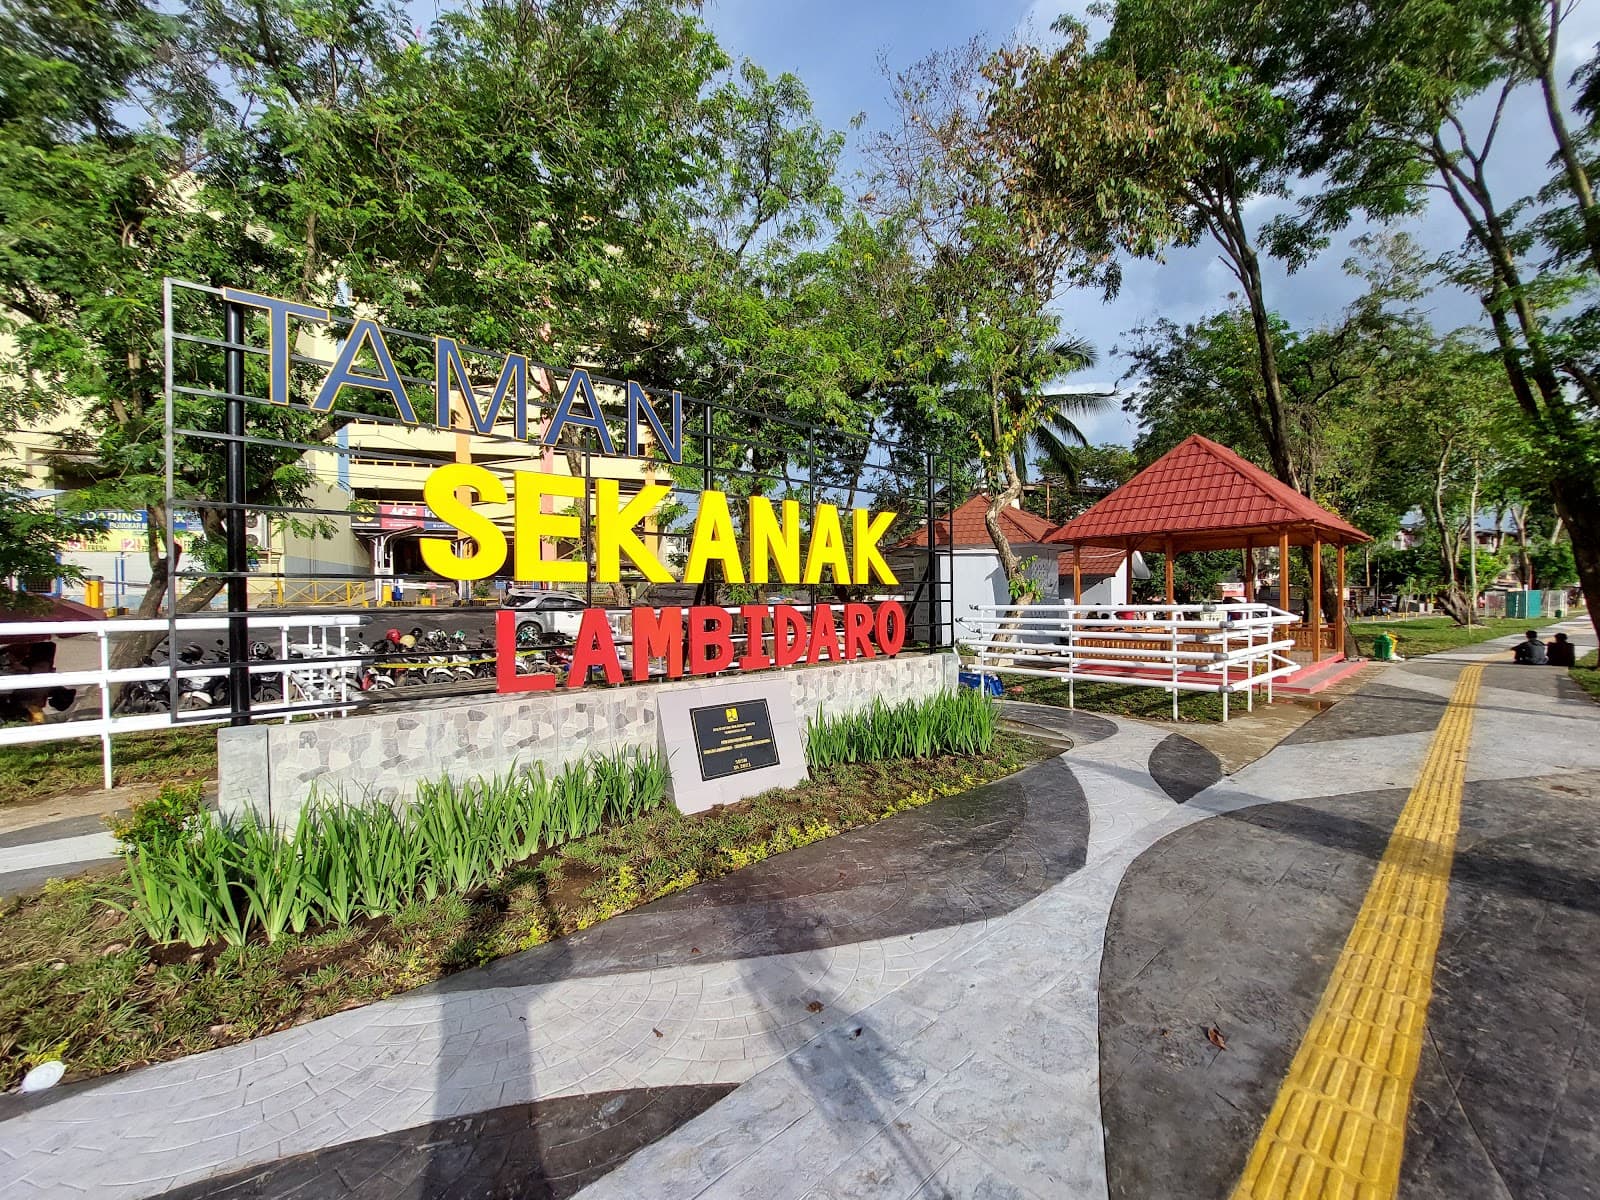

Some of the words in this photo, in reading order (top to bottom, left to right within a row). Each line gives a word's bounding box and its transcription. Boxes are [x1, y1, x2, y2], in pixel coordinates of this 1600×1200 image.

[223, 287, 683, 464] TAMAN
[420, 463, 900, 585] SEKANAK
[495, 600, 907, 694] LAMBIDARO
